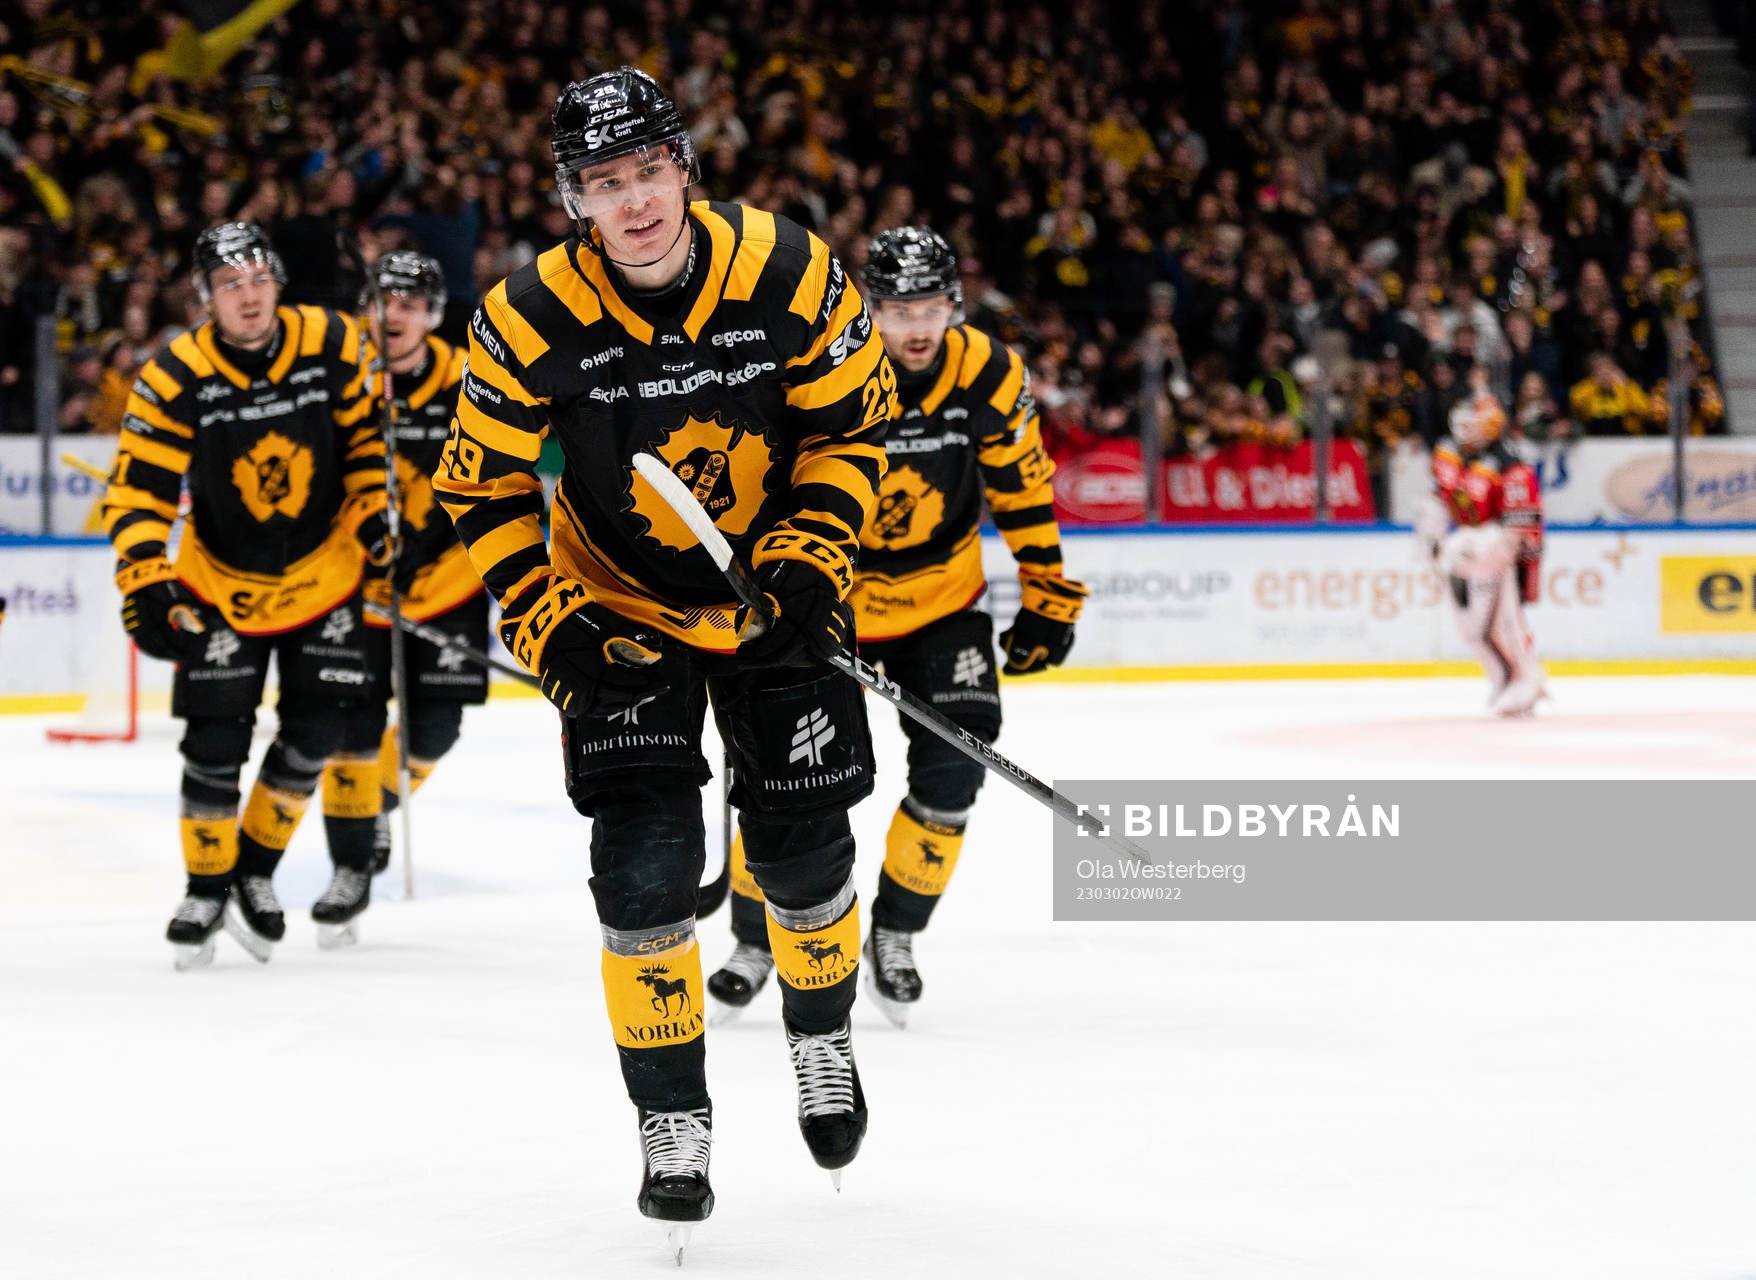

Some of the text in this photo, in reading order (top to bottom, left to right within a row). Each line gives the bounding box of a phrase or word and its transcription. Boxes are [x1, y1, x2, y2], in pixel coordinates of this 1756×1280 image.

[589, 105, 633, 124] CCM
[615, 127, 632, 138] Kraft
[472, 308, 505, 362] OLMEN
[661, 334, 684, 345] SHL
[711, 329, 766, 348] egcon
[662, 361, 695, 372] CCM
[643, 369, 723, 398] BOLIDEN
[441, 417, 485, 485] 29
[709, 496, 730, 509] 1921
[762, 536, 851, 591] CCM
[517, 583, 586, 668] CCM
[582, 731, 688, 755] martinsons
[956, 727, 1027, 781] JETSPEED
[764, 764, 863, 792] martinsons
[638, 931, 680, 951] CCM
